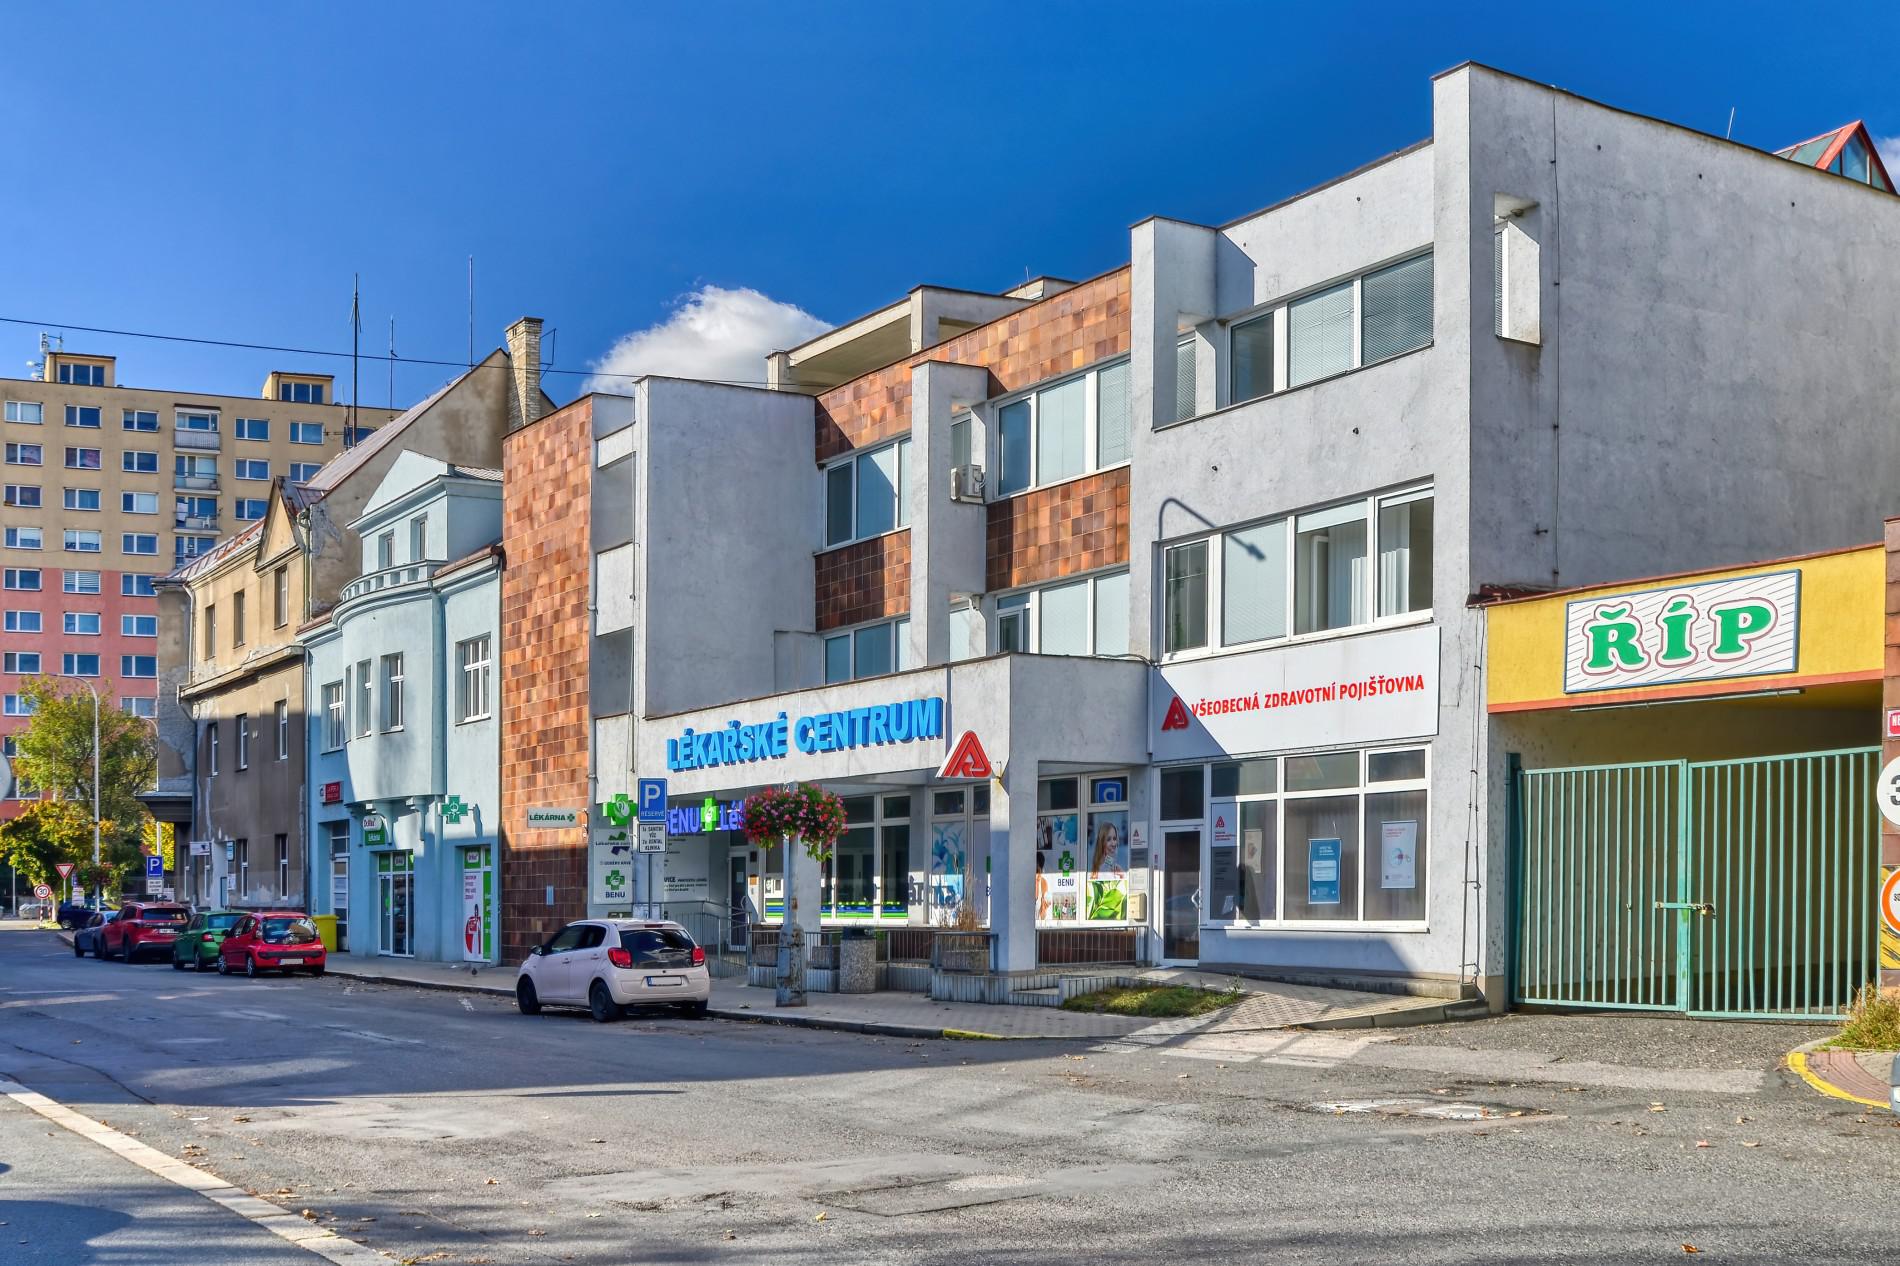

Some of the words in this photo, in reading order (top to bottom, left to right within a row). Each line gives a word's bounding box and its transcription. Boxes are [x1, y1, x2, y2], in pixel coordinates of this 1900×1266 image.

[1584, 598, 1774, 671] ŘÍP
[1190, 692, 1260, 717] VŠEOBECNÁ
[1264, 682, 1336, 709] ZDRAVOTNÍ
[1339, 674, 1425, 701] POJIŠŤOVNA
[667, 711, 788, 772] LÉKAŘSKÉ
[794, 696, 944, 754] CENTRUM
[644, 784, 661, 809] P
[529, 812, 566, 821] LÉKÁRNA
[666, 806, 700, 834] ENU
[150, 858, 160, 872] P
[38, 887, 48, 896] 30
[1057, 878, 1075, 887] BENU
